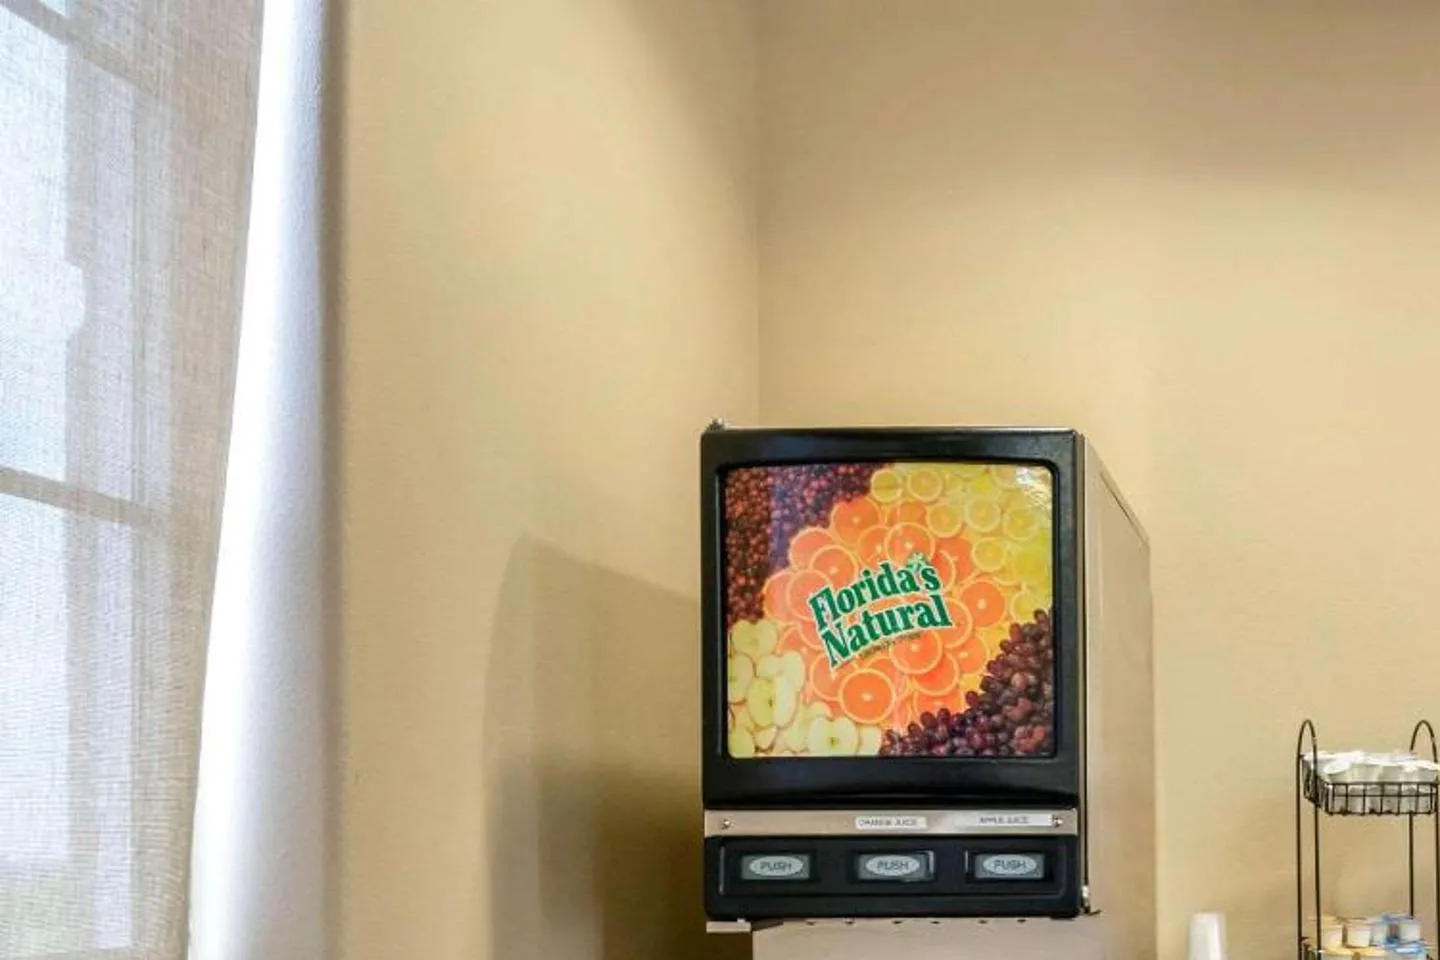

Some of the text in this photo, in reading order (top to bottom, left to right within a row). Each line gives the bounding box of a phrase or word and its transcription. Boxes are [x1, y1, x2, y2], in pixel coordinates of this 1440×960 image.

[809, 561, 941, 631] Florida's
[821, 594, 953, 668] Natural
[759, 861, 793, 871] PUSH
[876, 860, 911, 870] PUSH
[993, 859, 1027, 869] PUSH
